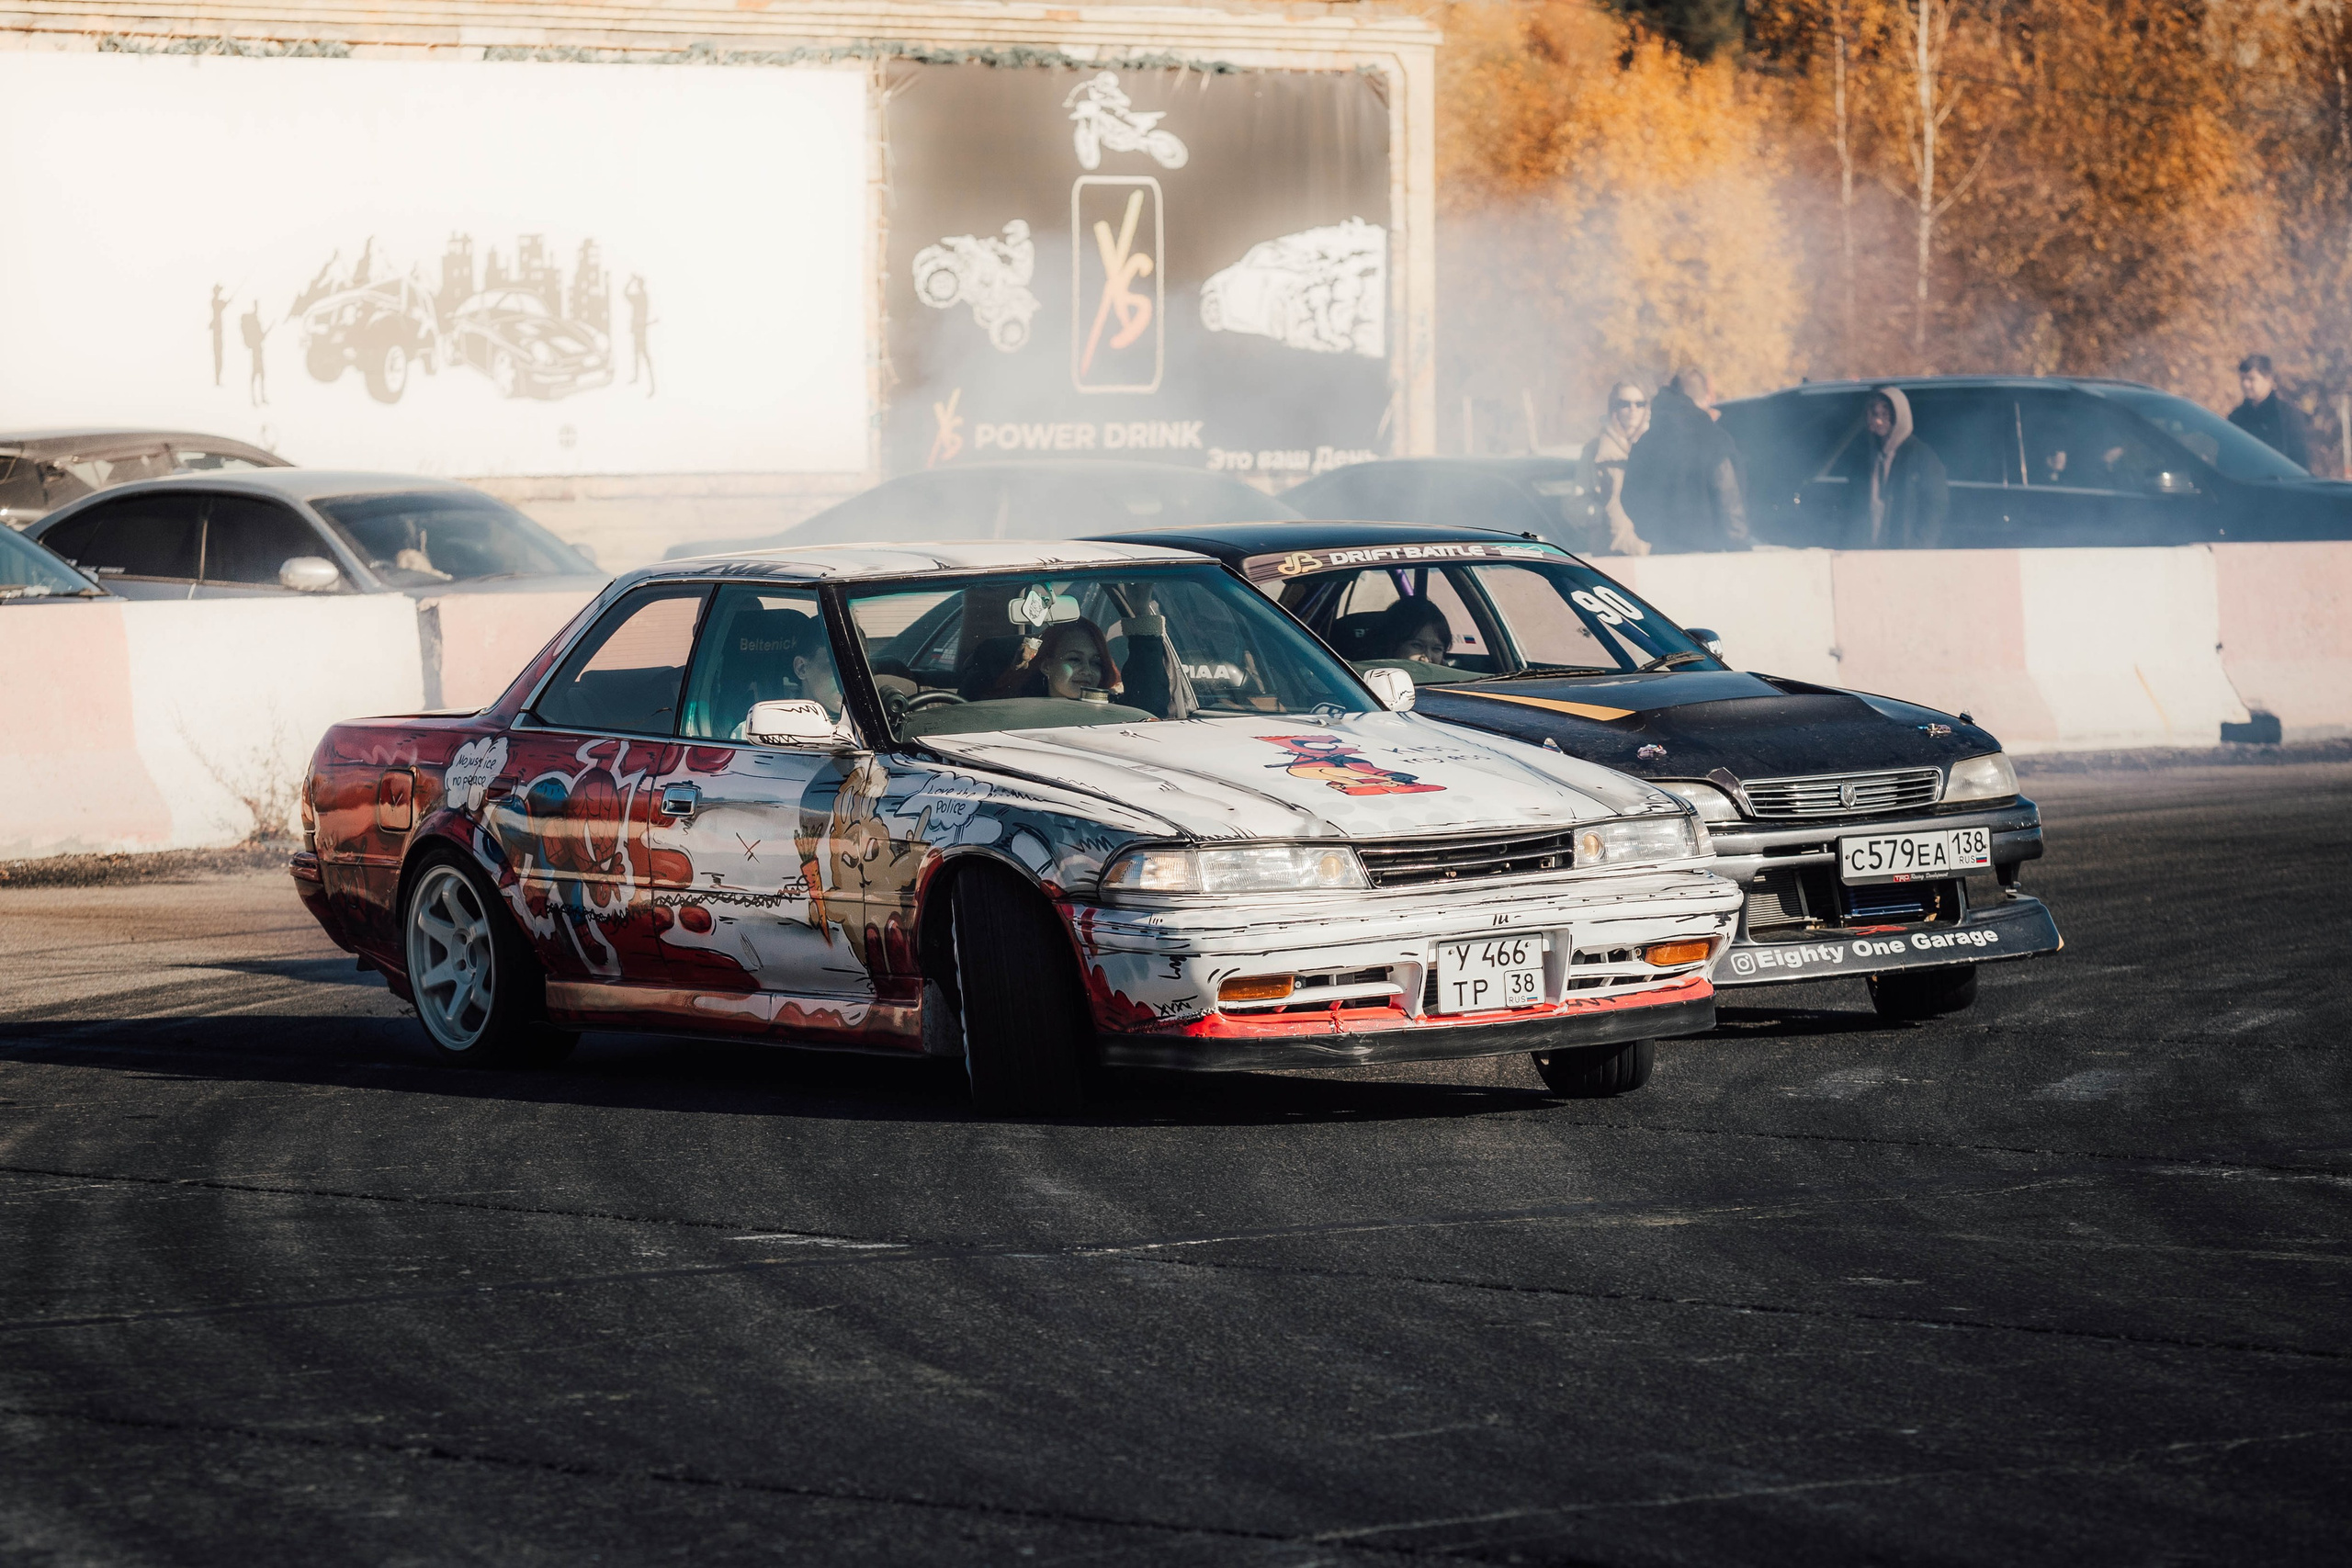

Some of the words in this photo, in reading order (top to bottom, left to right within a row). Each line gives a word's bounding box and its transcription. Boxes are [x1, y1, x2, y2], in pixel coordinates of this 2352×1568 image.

[974, 422, 1097, 450] POWER
[1104, 420, 1204, 449] DRINK
[1206, 447, 1254, 470] Это
[1256, 450, 1311, 470] ваш
[1571, 585, 1645, 626] 90
[461, 774, 486, 790] peace
[926, 784, 955, 795] Love
[1851, 838, 1947, 872] С579ЕА
[1951, 830, 1985, 855] 138
[1959, 854, 1975, 864] RUS
[1482, 939, 1526, 968] 466
[1756, 944, 1844, 969] Eighty
[1851, 940, 1906, 957] One
[1910, 929, 1999, 950] Garage
[1453, 978, 1488, 1007] ТР
[1511, 973, 1534, 994] 38
[1509, 996, 1526, 1004] RUS
